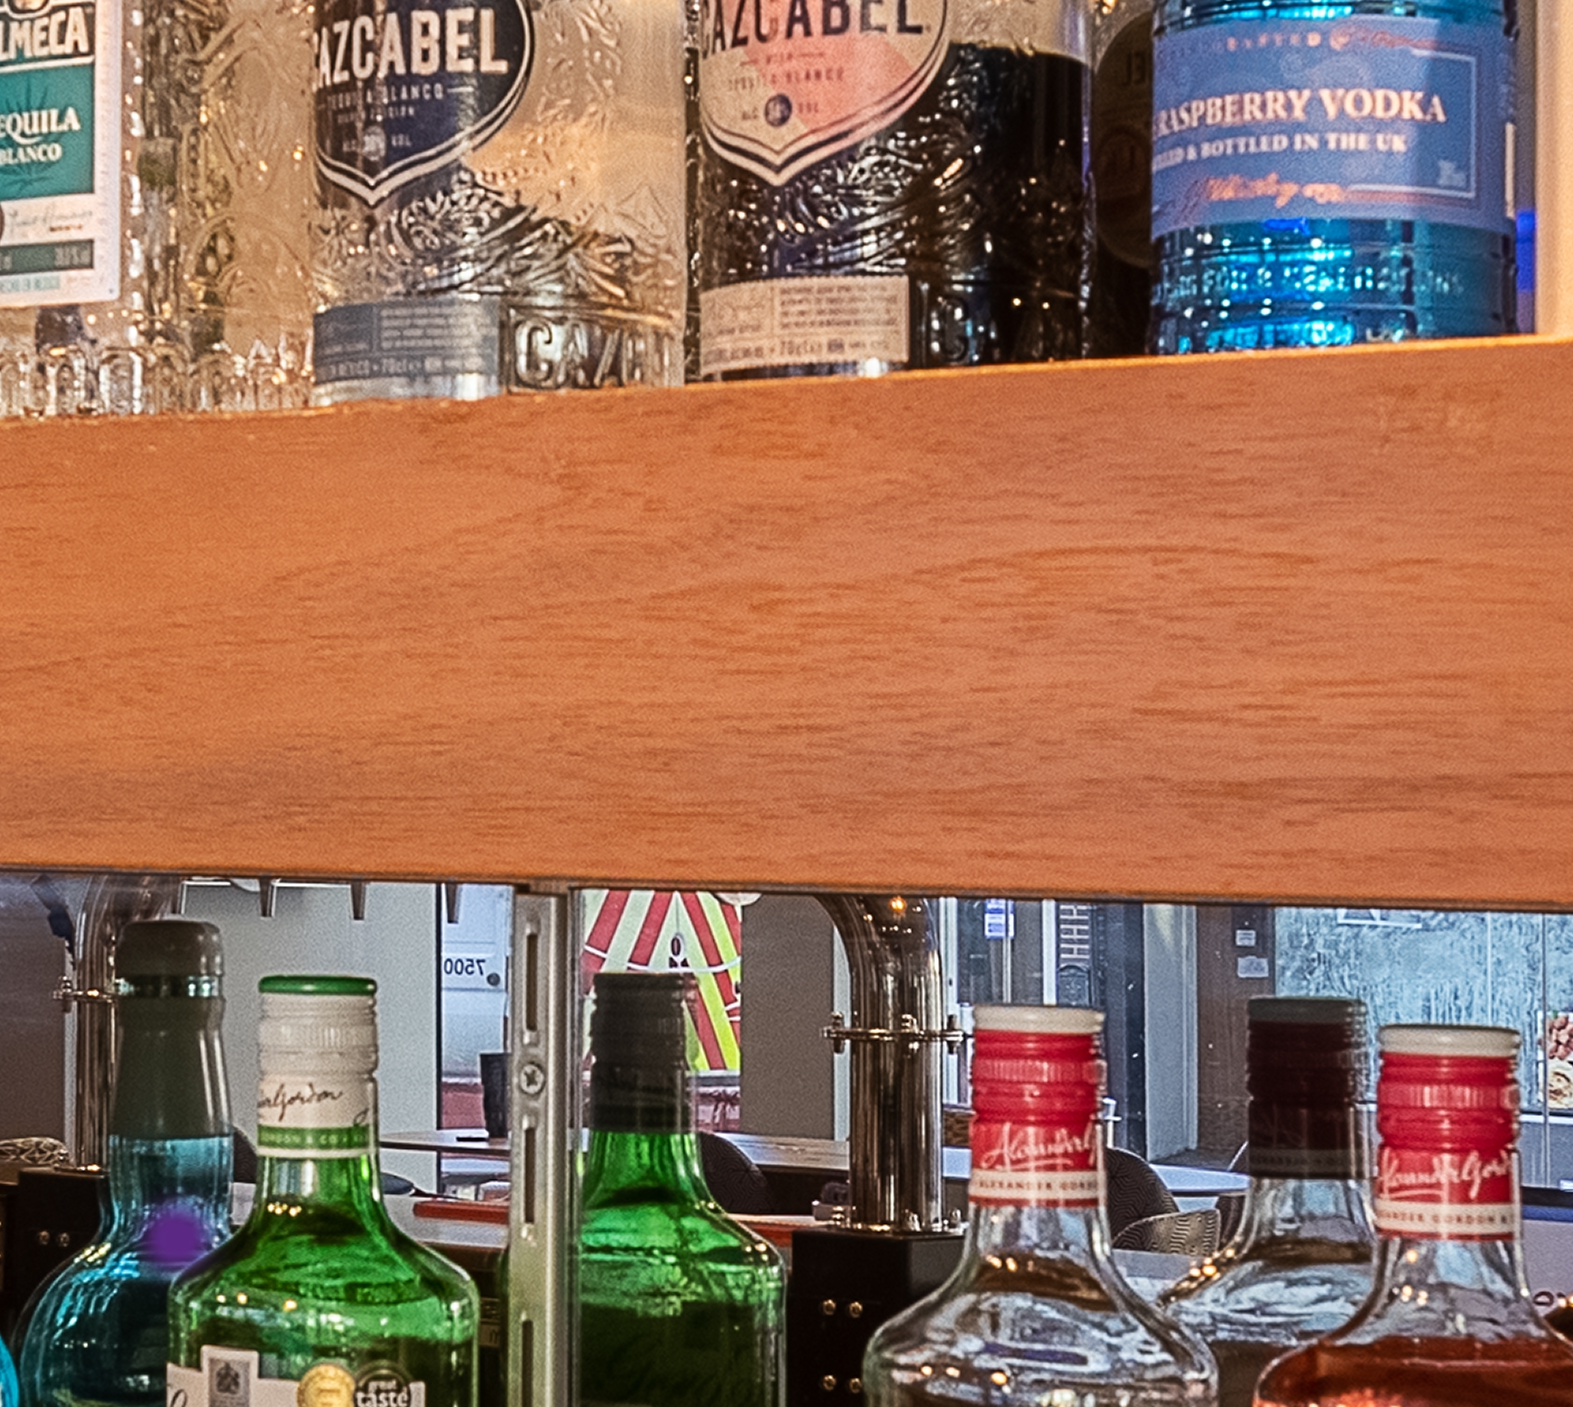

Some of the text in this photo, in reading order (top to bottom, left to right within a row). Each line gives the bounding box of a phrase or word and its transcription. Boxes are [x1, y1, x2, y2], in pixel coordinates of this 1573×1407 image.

[1319, 88, 1448, 123] VODKA
[1200, 134, 1289, 158] BOTTLED
[1293, 132, 1320, 151] IN
[1325, 132, 1369, 152] THE
[1375, 133, 1408, 153] UK
